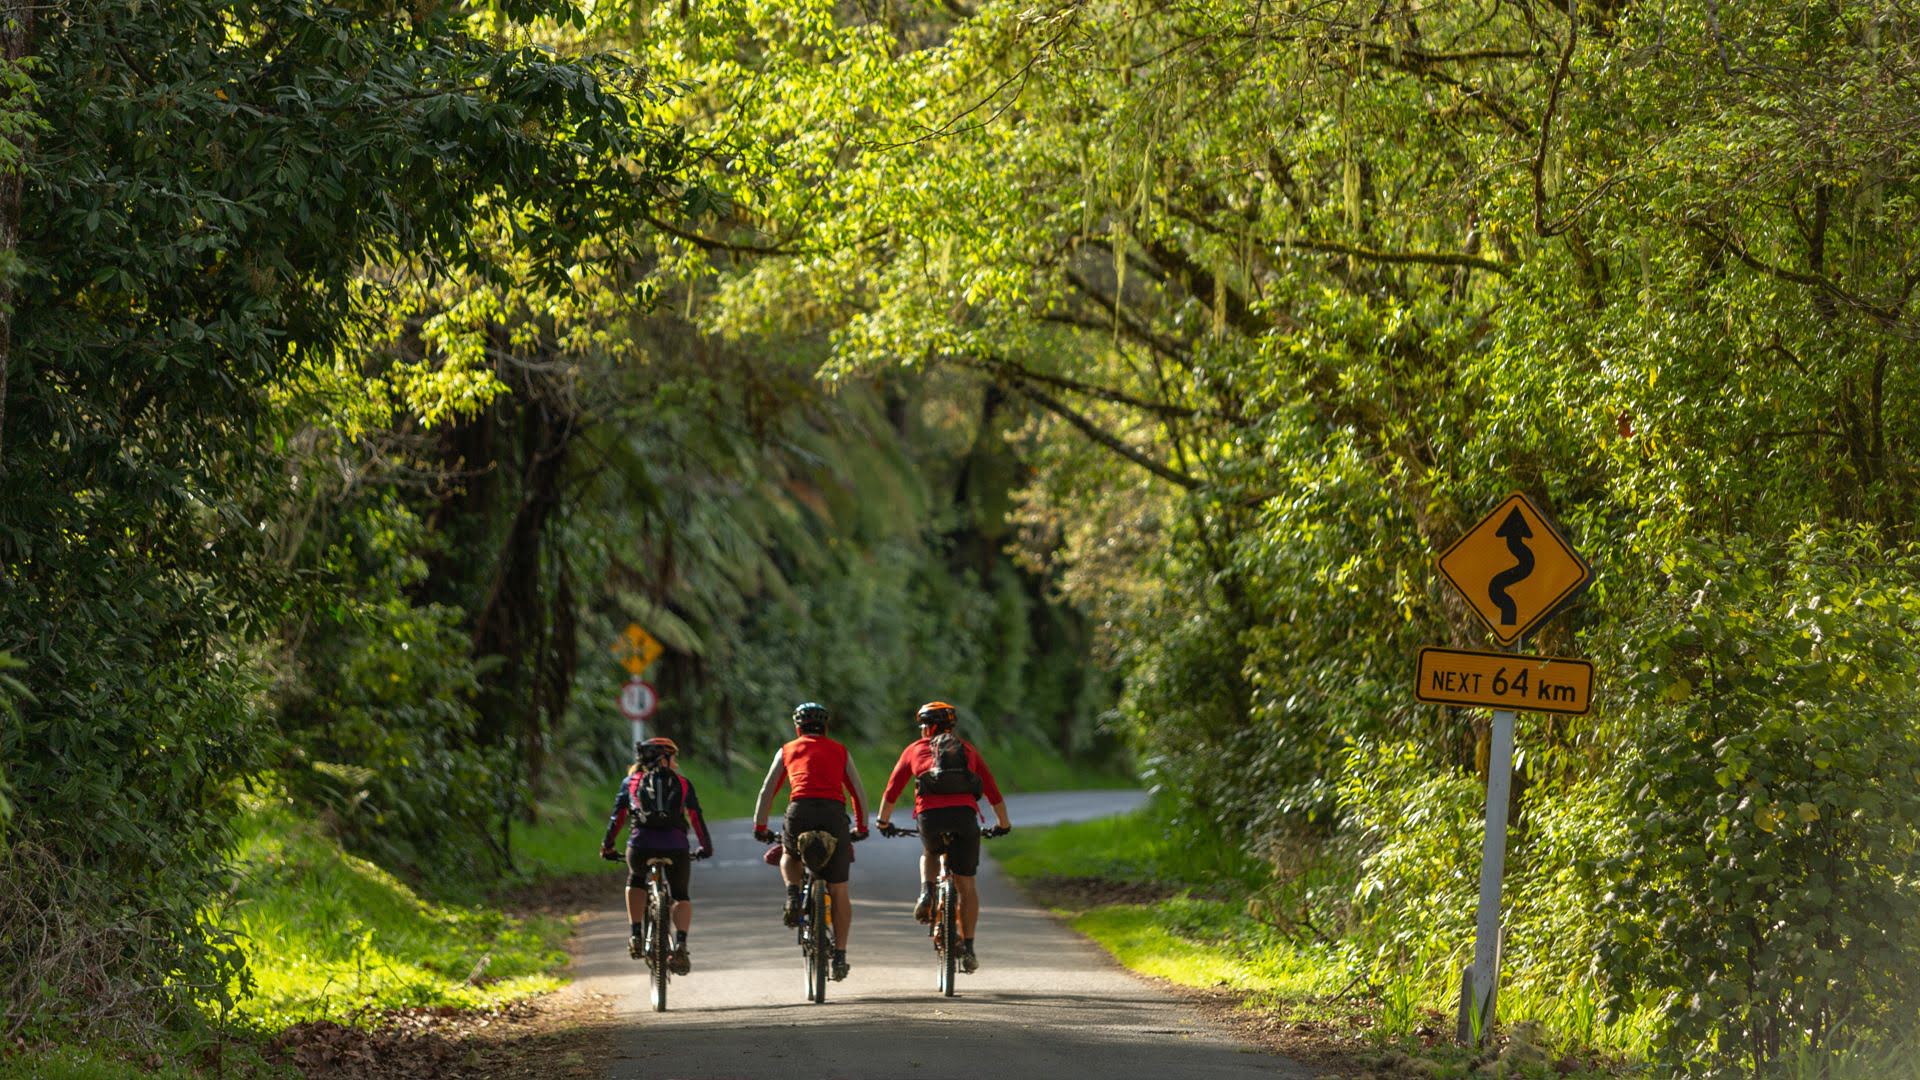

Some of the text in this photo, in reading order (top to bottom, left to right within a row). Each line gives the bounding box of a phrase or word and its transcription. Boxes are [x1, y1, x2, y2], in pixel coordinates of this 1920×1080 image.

[1432, 667, 1576, 702] NEXT 64 km
